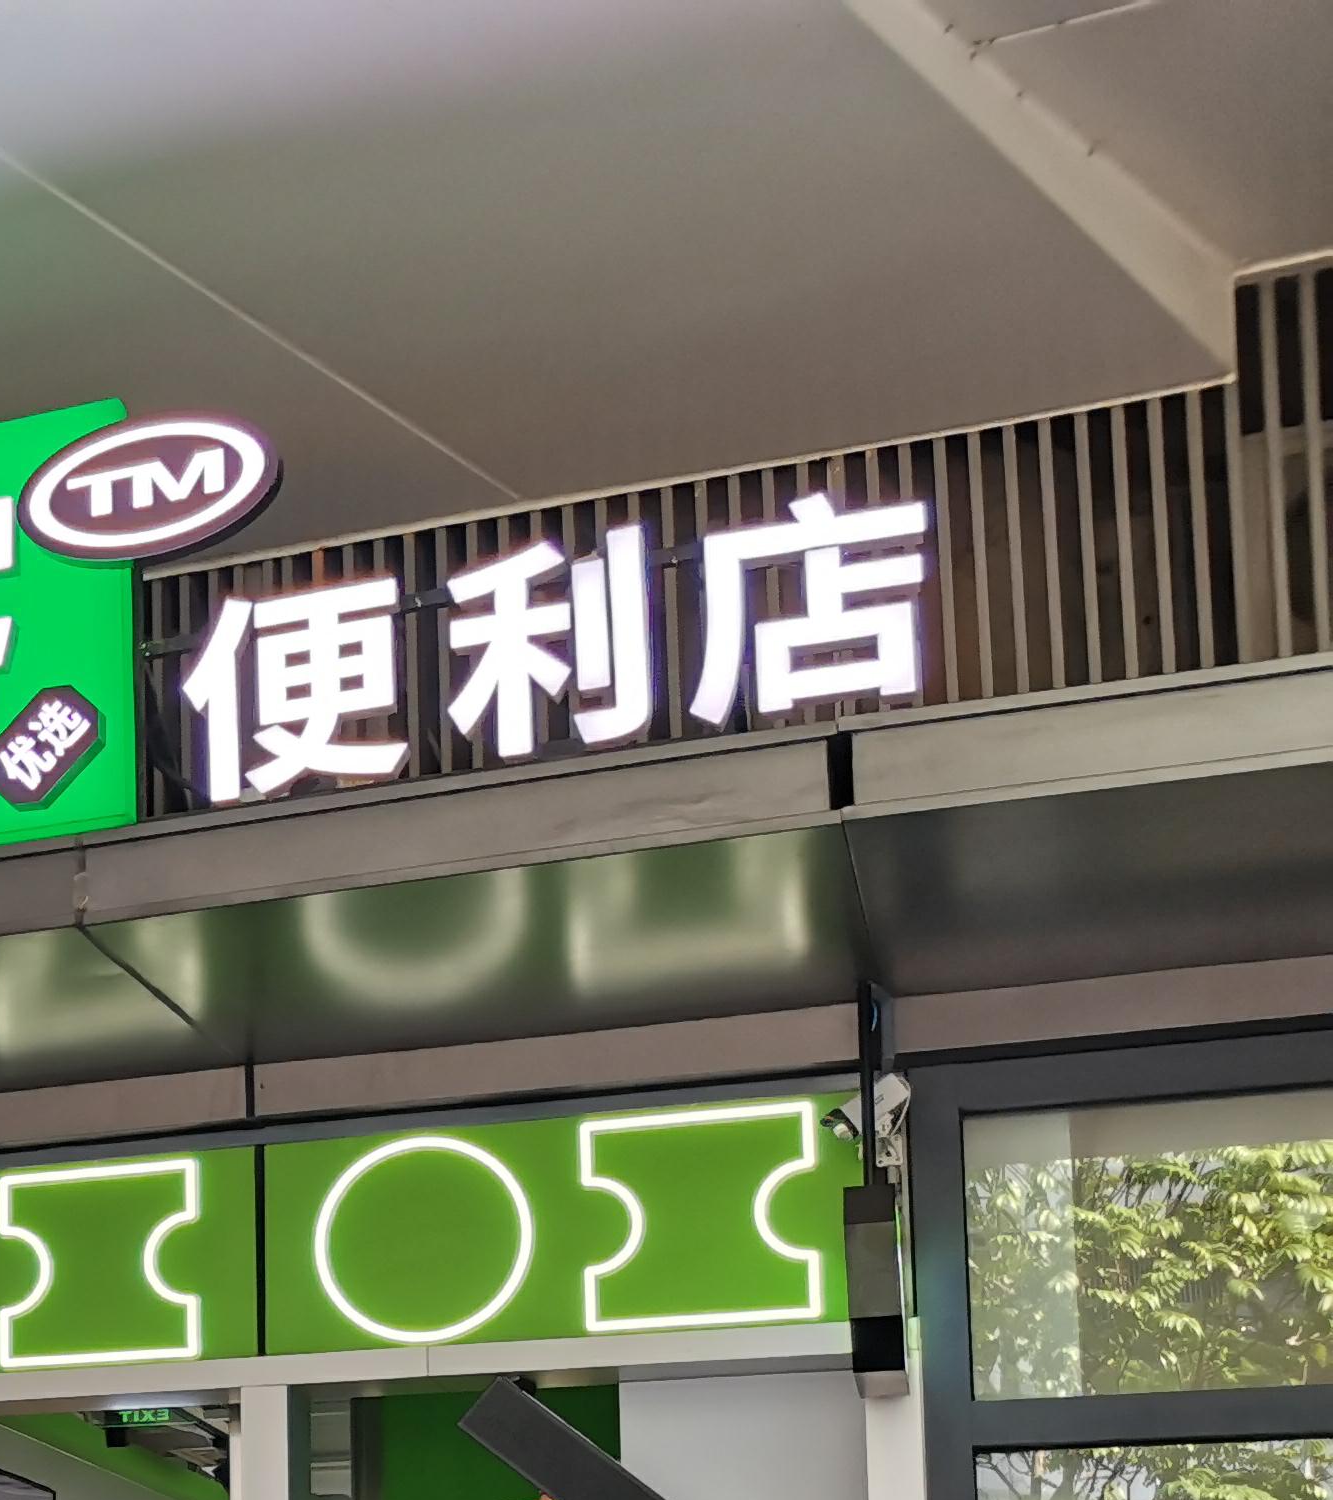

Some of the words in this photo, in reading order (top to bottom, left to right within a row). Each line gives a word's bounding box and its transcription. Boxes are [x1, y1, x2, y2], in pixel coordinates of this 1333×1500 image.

[66, 448, 225, 518] TM
[184, 493, 927, 802] 便利店
